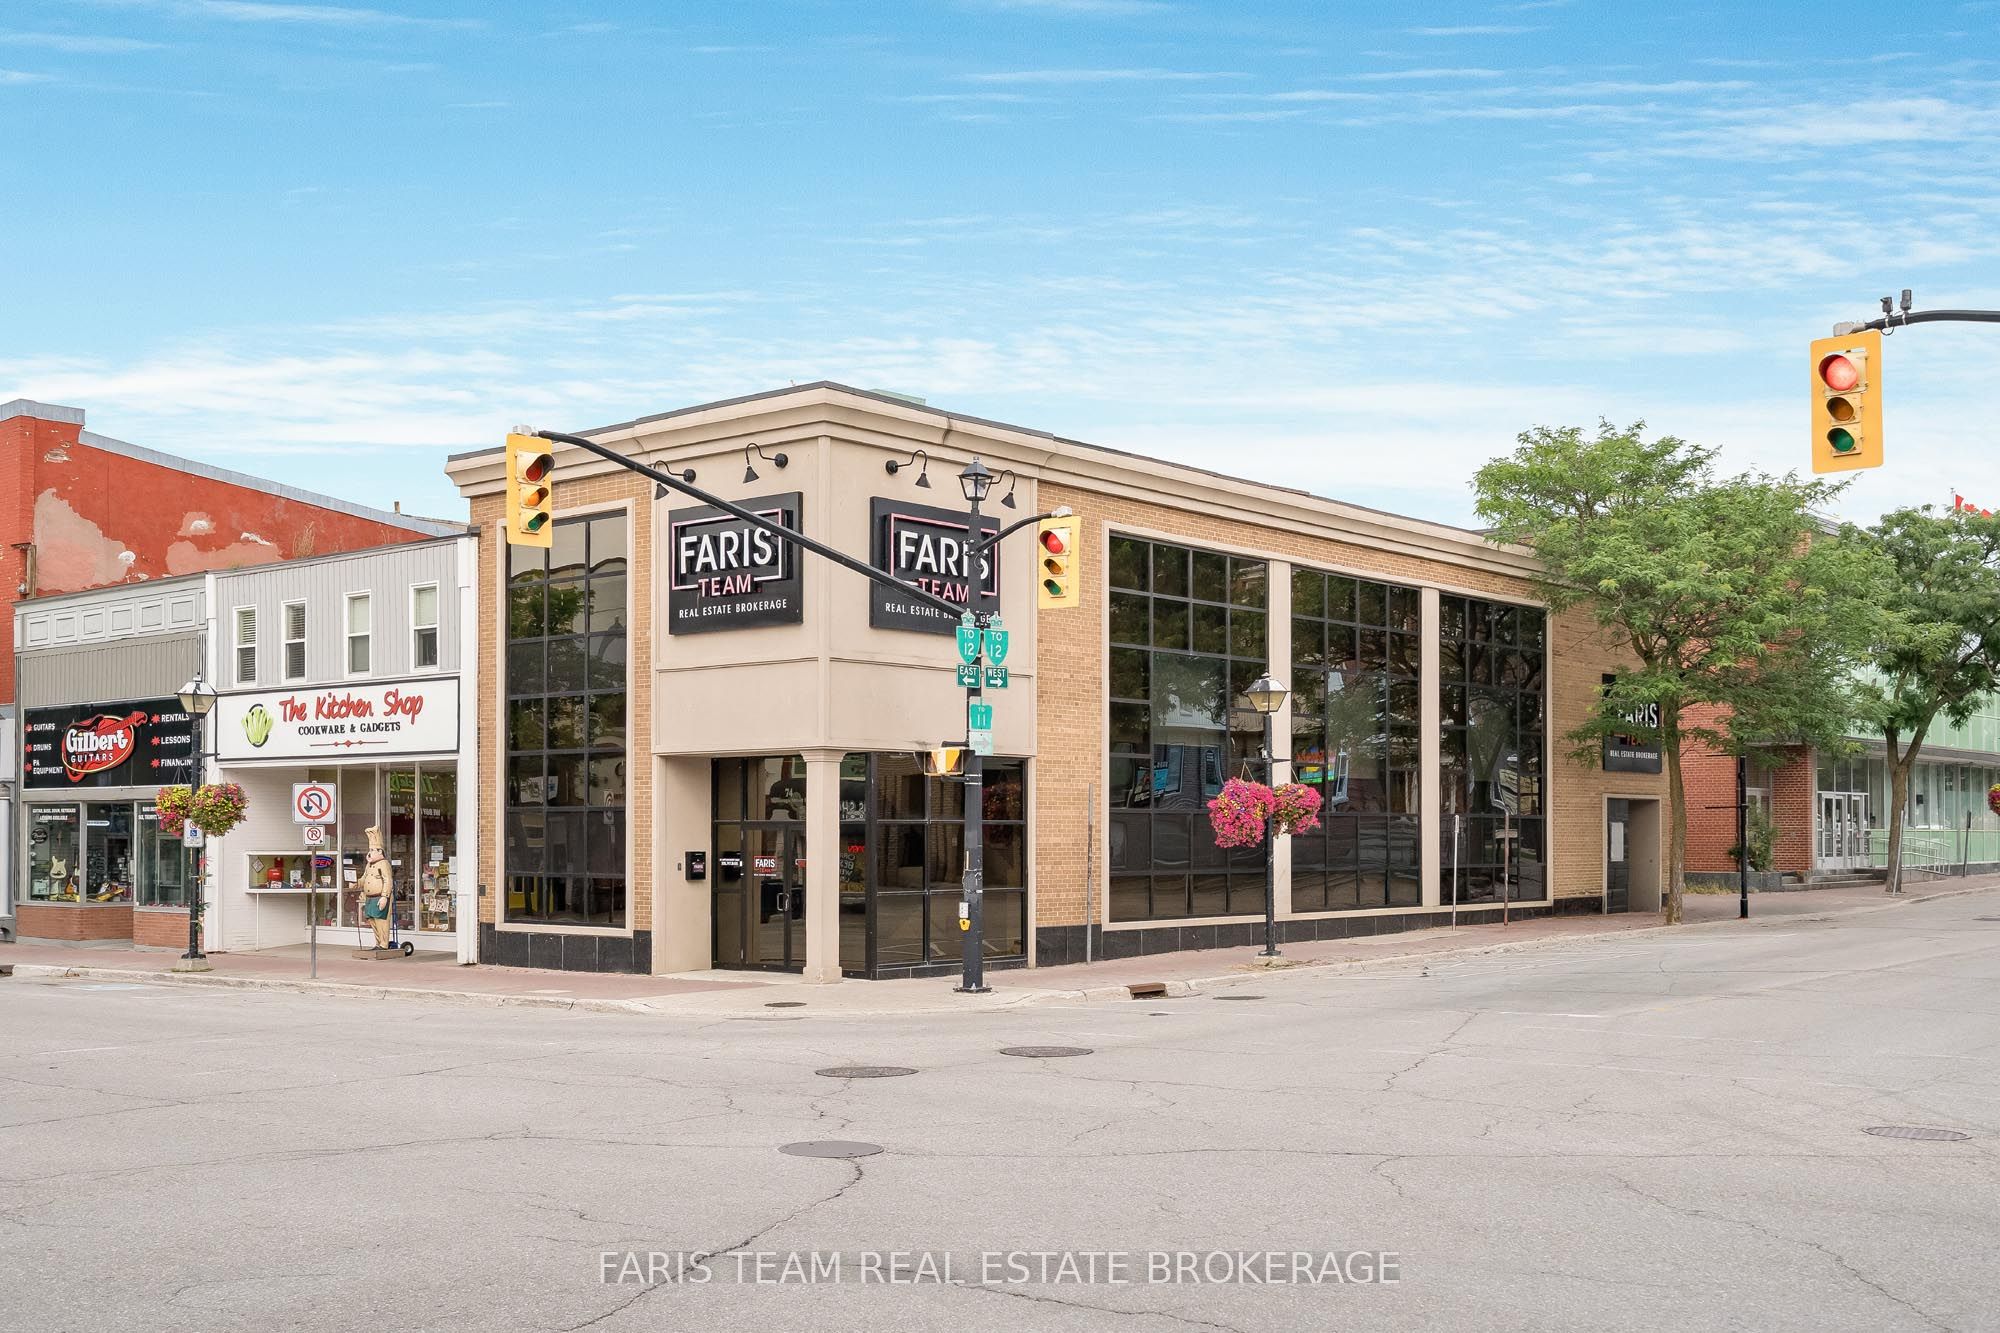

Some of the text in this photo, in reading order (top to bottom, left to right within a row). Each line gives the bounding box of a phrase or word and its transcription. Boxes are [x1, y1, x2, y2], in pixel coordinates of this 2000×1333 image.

[680, 527, 772, 574] FARIS
[698, 573, 751, 597] TEAM
[918, 578, 969, 603] TEAM
[679, 598, 787, 619] REAL ESTATE BROKERAGE
[885, 602, 907, 614] REAL
[910, 605, 939, 618] ESTATE
[963, 629, 975, 639] TO
[991, 631, 1003, 641] TO
[964, 642, 975, 656] 12
[990, 644, 1002, 658] 12
[959, 666, 977, 675] EAST
[987, 668, 1005, 678] WEST
[279, 688, 424, 725] The Kitchen Shop
[161, 713, 190, 722] RENTALS
[977, 714, 986, 726] 11
[33, 723, 56, 731] GUITARS
[298, 721, 401, 736] COOKWARE & GADGETS
[66, 728, 128, 753] Gilbert
[160, 735, 191, 745] LESSONS
[33, 743, 52, 751] DRUMS
[70, 753, 114, 763] GUITARS
[160, 758, 193, 767] FINANCIN
[33, 766, 63, 775] EQUIPMENT
[755, 858, 776, 868] FARIS
